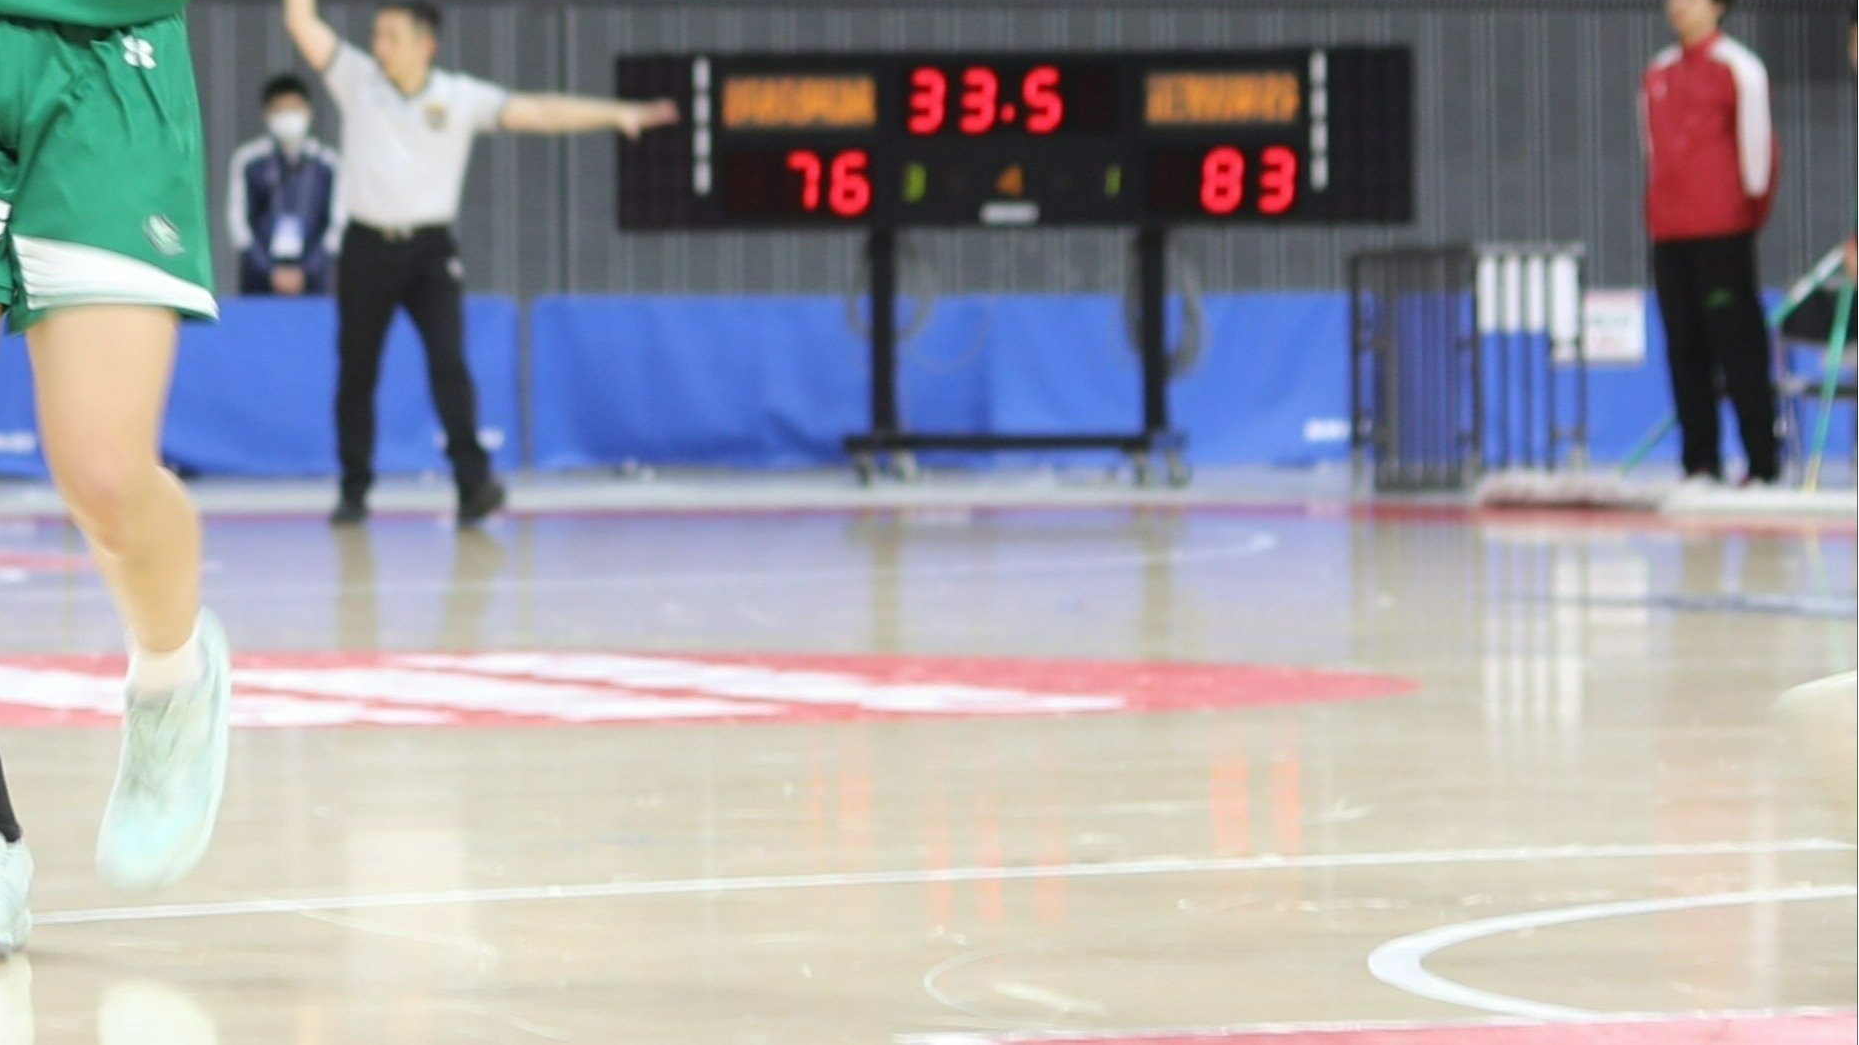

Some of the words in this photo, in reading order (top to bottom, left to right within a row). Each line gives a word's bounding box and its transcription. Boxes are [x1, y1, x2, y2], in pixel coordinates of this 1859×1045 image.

[907, 64, 1064, 135] 33.5
[787, 148, 872, 218] 76
[1200, 144, 1298, 215] 83
